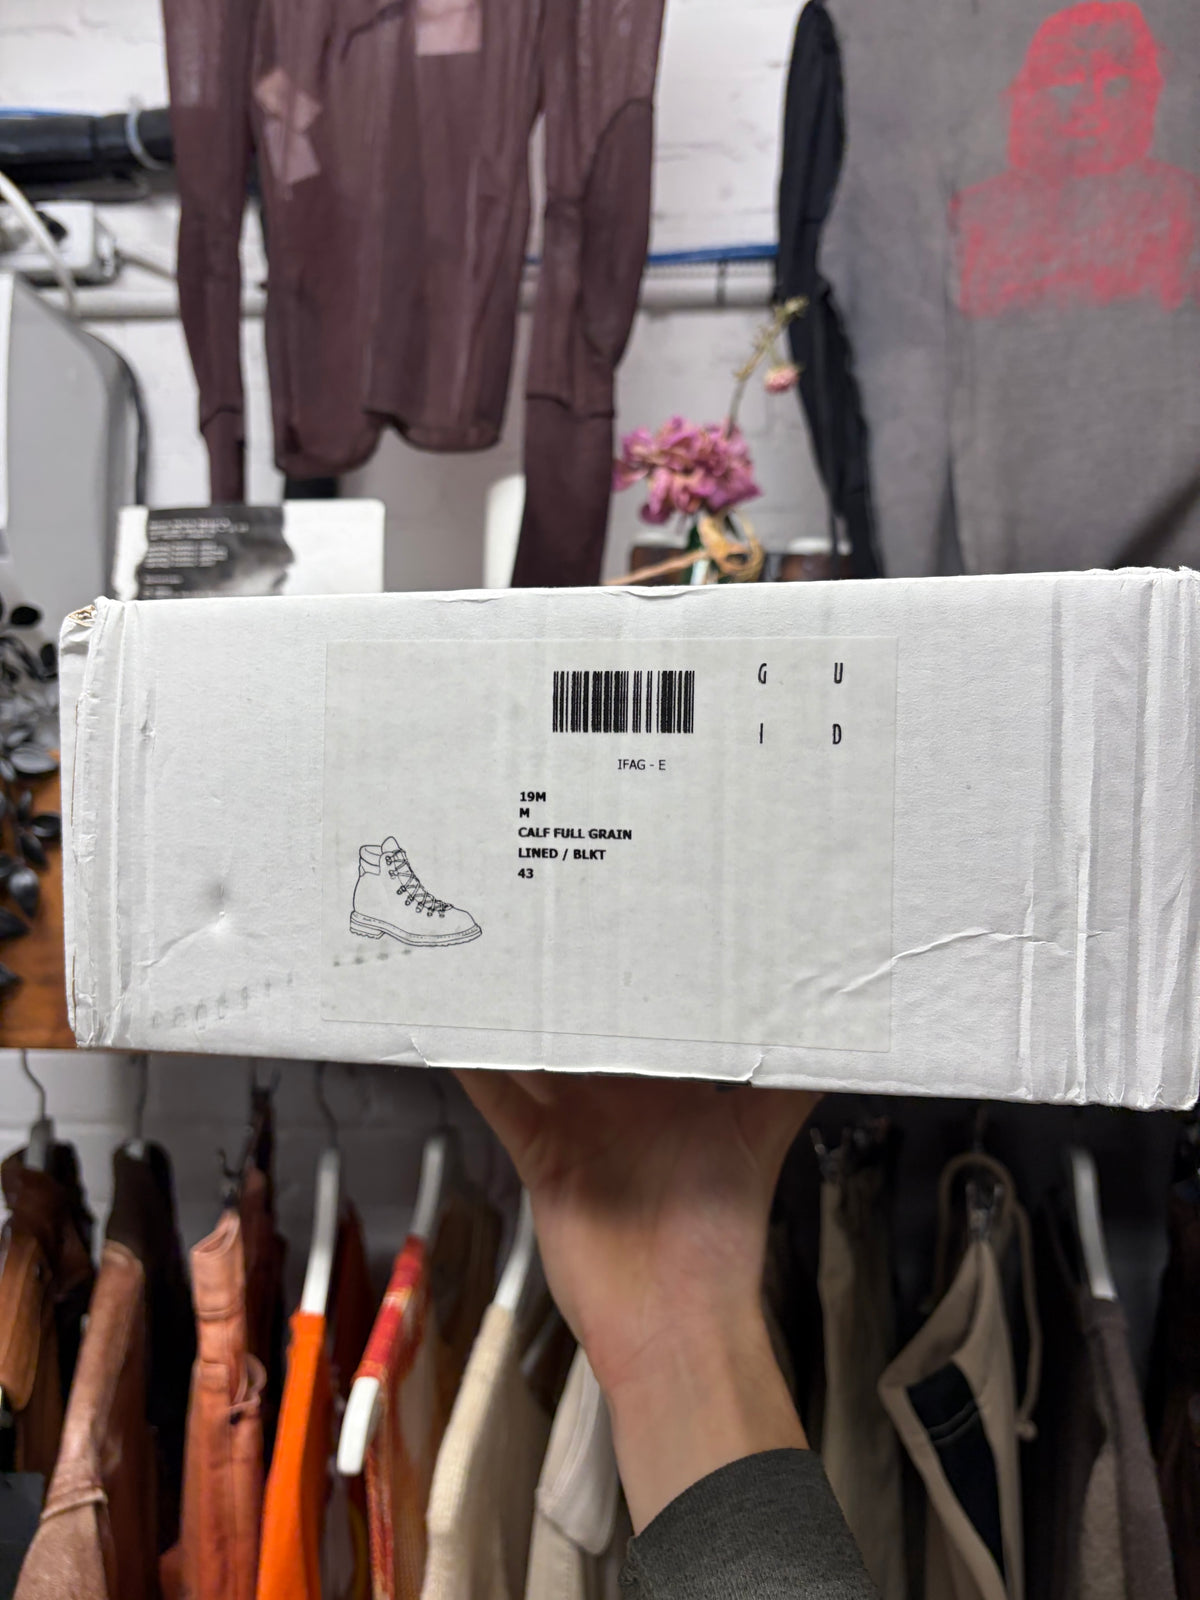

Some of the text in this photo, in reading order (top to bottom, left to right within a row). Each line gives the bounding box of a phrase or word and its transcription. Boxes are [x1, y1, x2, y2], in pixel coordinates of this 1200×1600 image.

[758, 663, 844, 685] G U
[832, 724, 842, 745] D
[617, 758, 646, 771] IFAG
[658, 759, 667, 771] E
[519, 790, 547, 803] 19M
[519, 807, 531, 819] M
[517, 826, 633, 841] CALF FULL GRAIN
[518, 847, 559, 860] LINED
[572, 848, 607, 861] BLKT
[517, 867, 535, 880] 43
